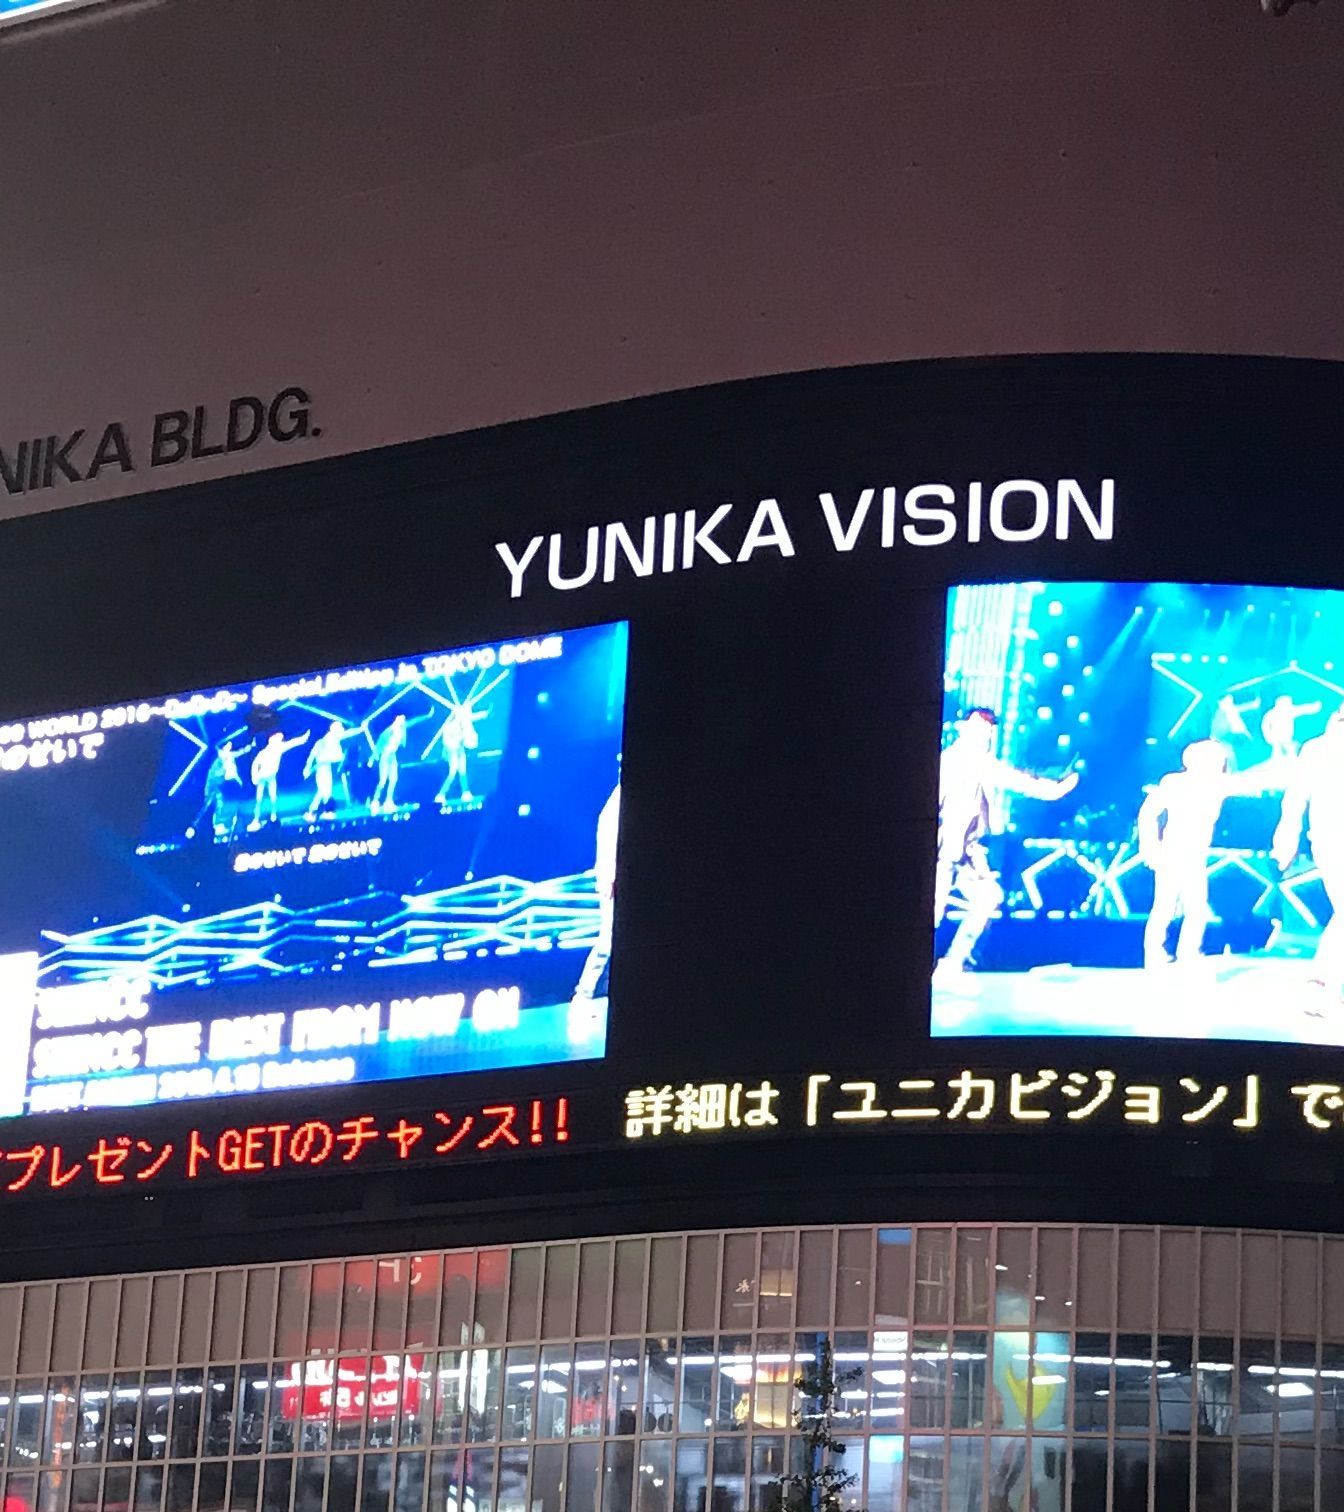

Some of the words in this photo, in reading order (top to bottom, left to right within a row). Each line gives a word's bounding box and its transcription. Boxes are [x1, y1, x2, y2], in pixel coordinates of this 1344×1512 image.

[151, 387, 323, 468] BLDG.
[496, 497, 796, 598] YUNIKA
[817, 477, 1116, 552] VISION
